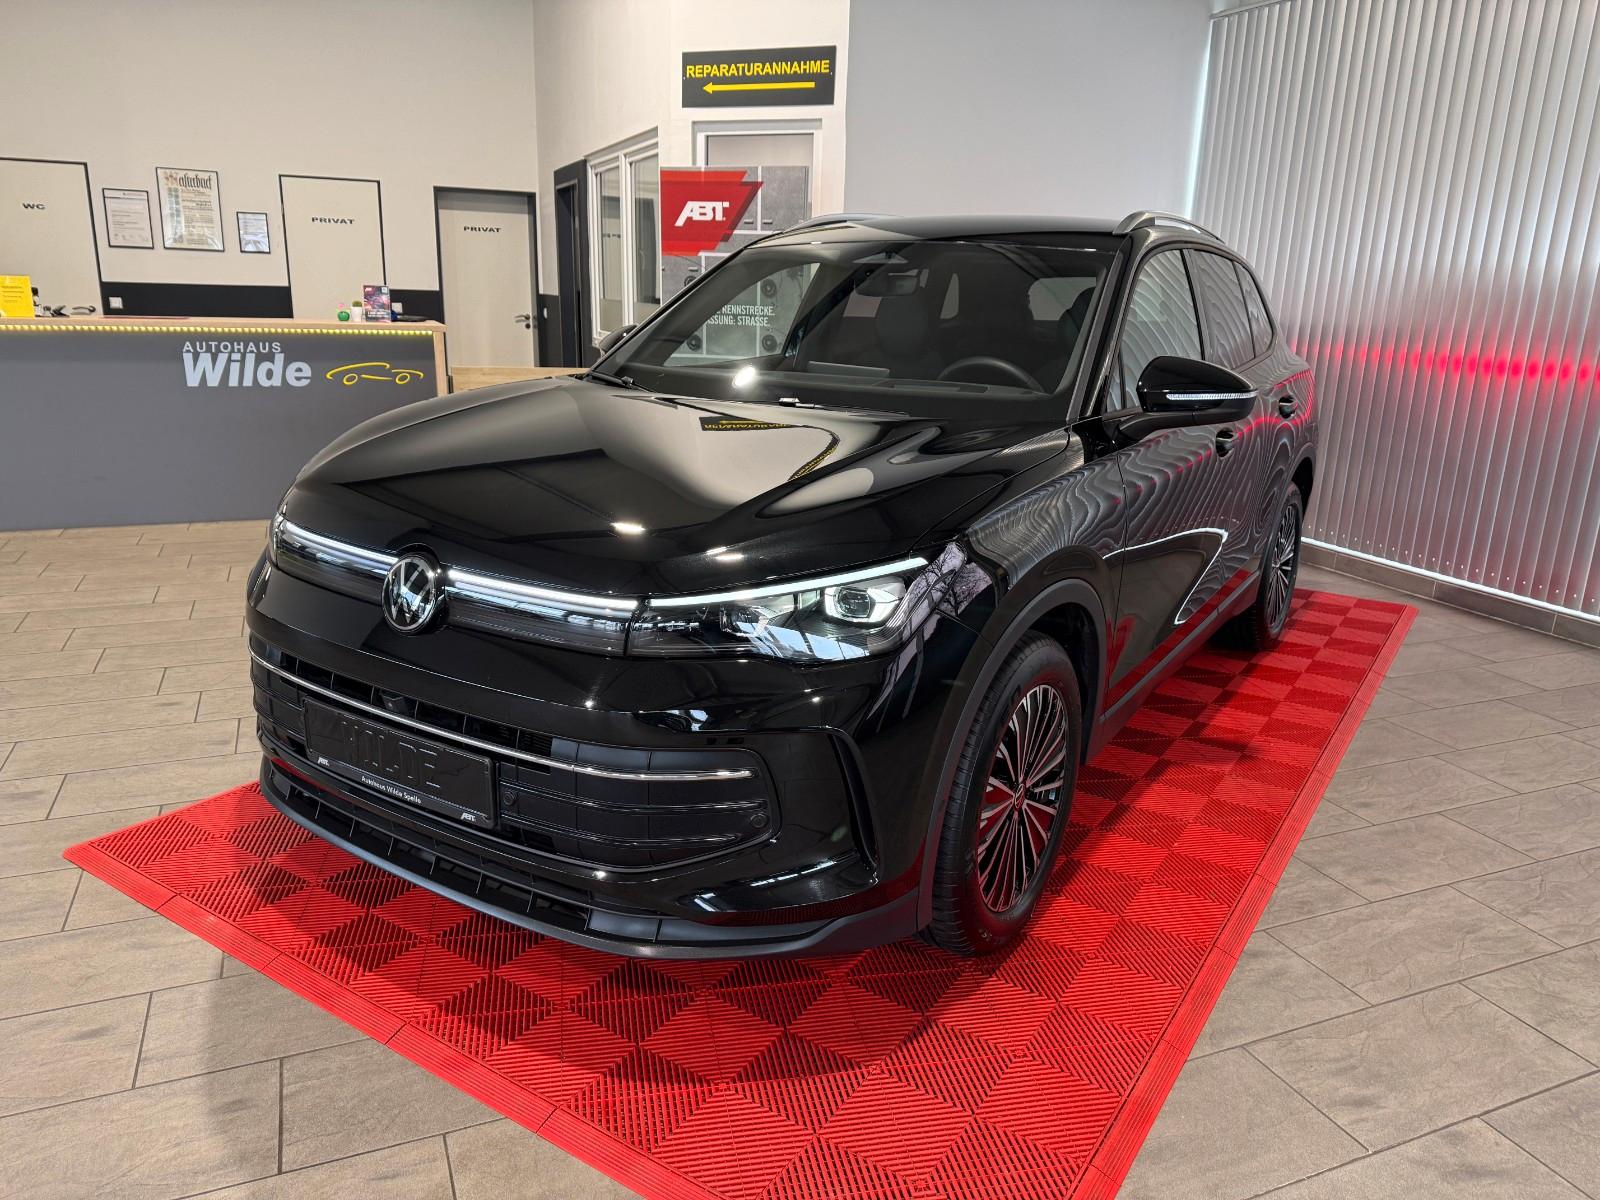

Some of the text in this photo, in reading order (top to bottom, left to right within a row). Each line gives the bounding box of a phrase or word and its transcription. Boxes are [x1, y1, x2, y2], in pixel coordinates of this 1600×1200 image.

[686, 60, 830, 79] REPARATURANNAHME
[311, 216, 355, 225] PRIVAT
[674, 201, 730, 227] ABT
[463, 225, 502, 233] PRIVAT
[183, 341, 282, 353] AUTOHAUS
[183, 353, 312, 387] Wilde
